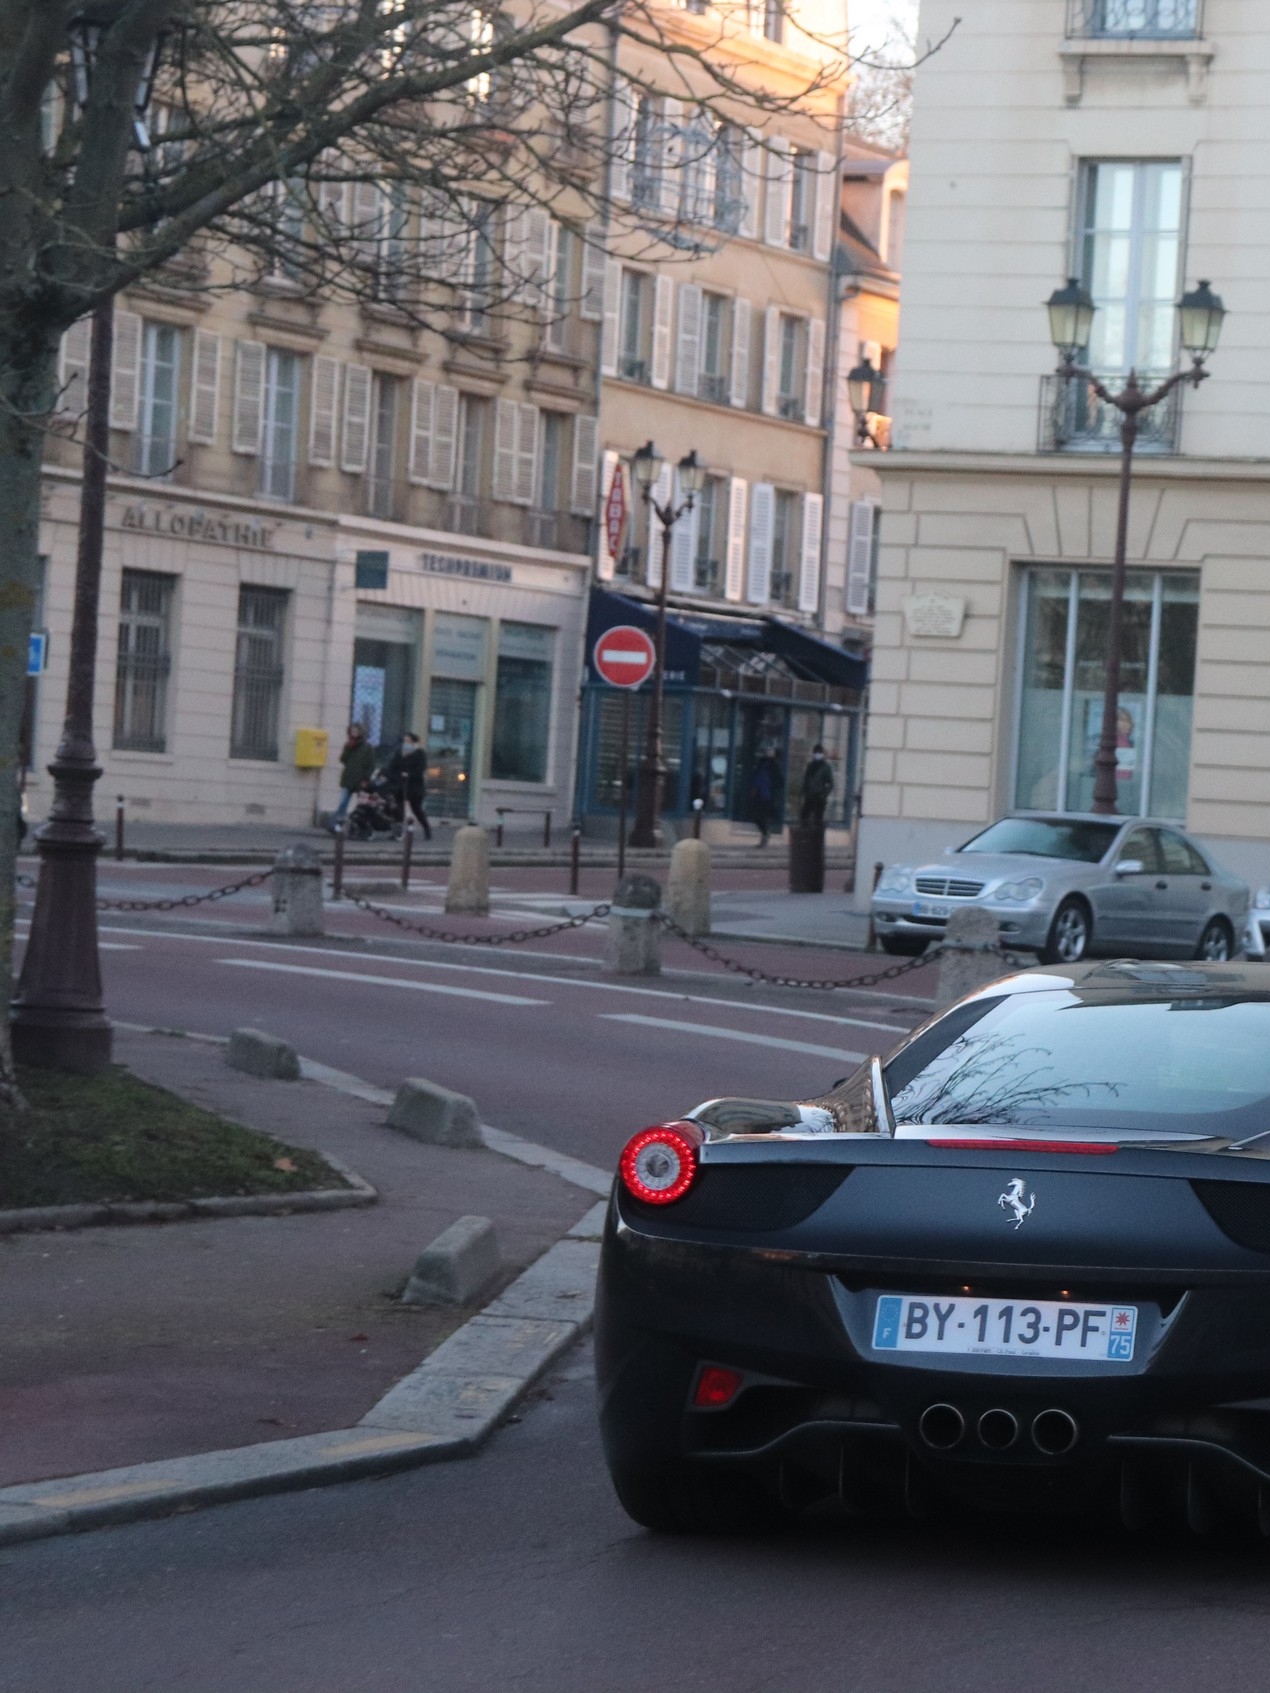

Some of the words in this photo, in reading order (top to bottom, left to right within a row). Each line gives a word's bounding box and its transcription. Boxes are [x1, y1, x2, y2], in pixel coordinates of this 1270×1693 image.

[121, 506, 273, 548] ALLOPATHIE
[608, 471, 623, 551] TABAC
[882, 1327, 892, 1340] F
[904, 1301, 1107, 1348] BY-113-PF
[1110, 1334, 1132, 1356] 75
